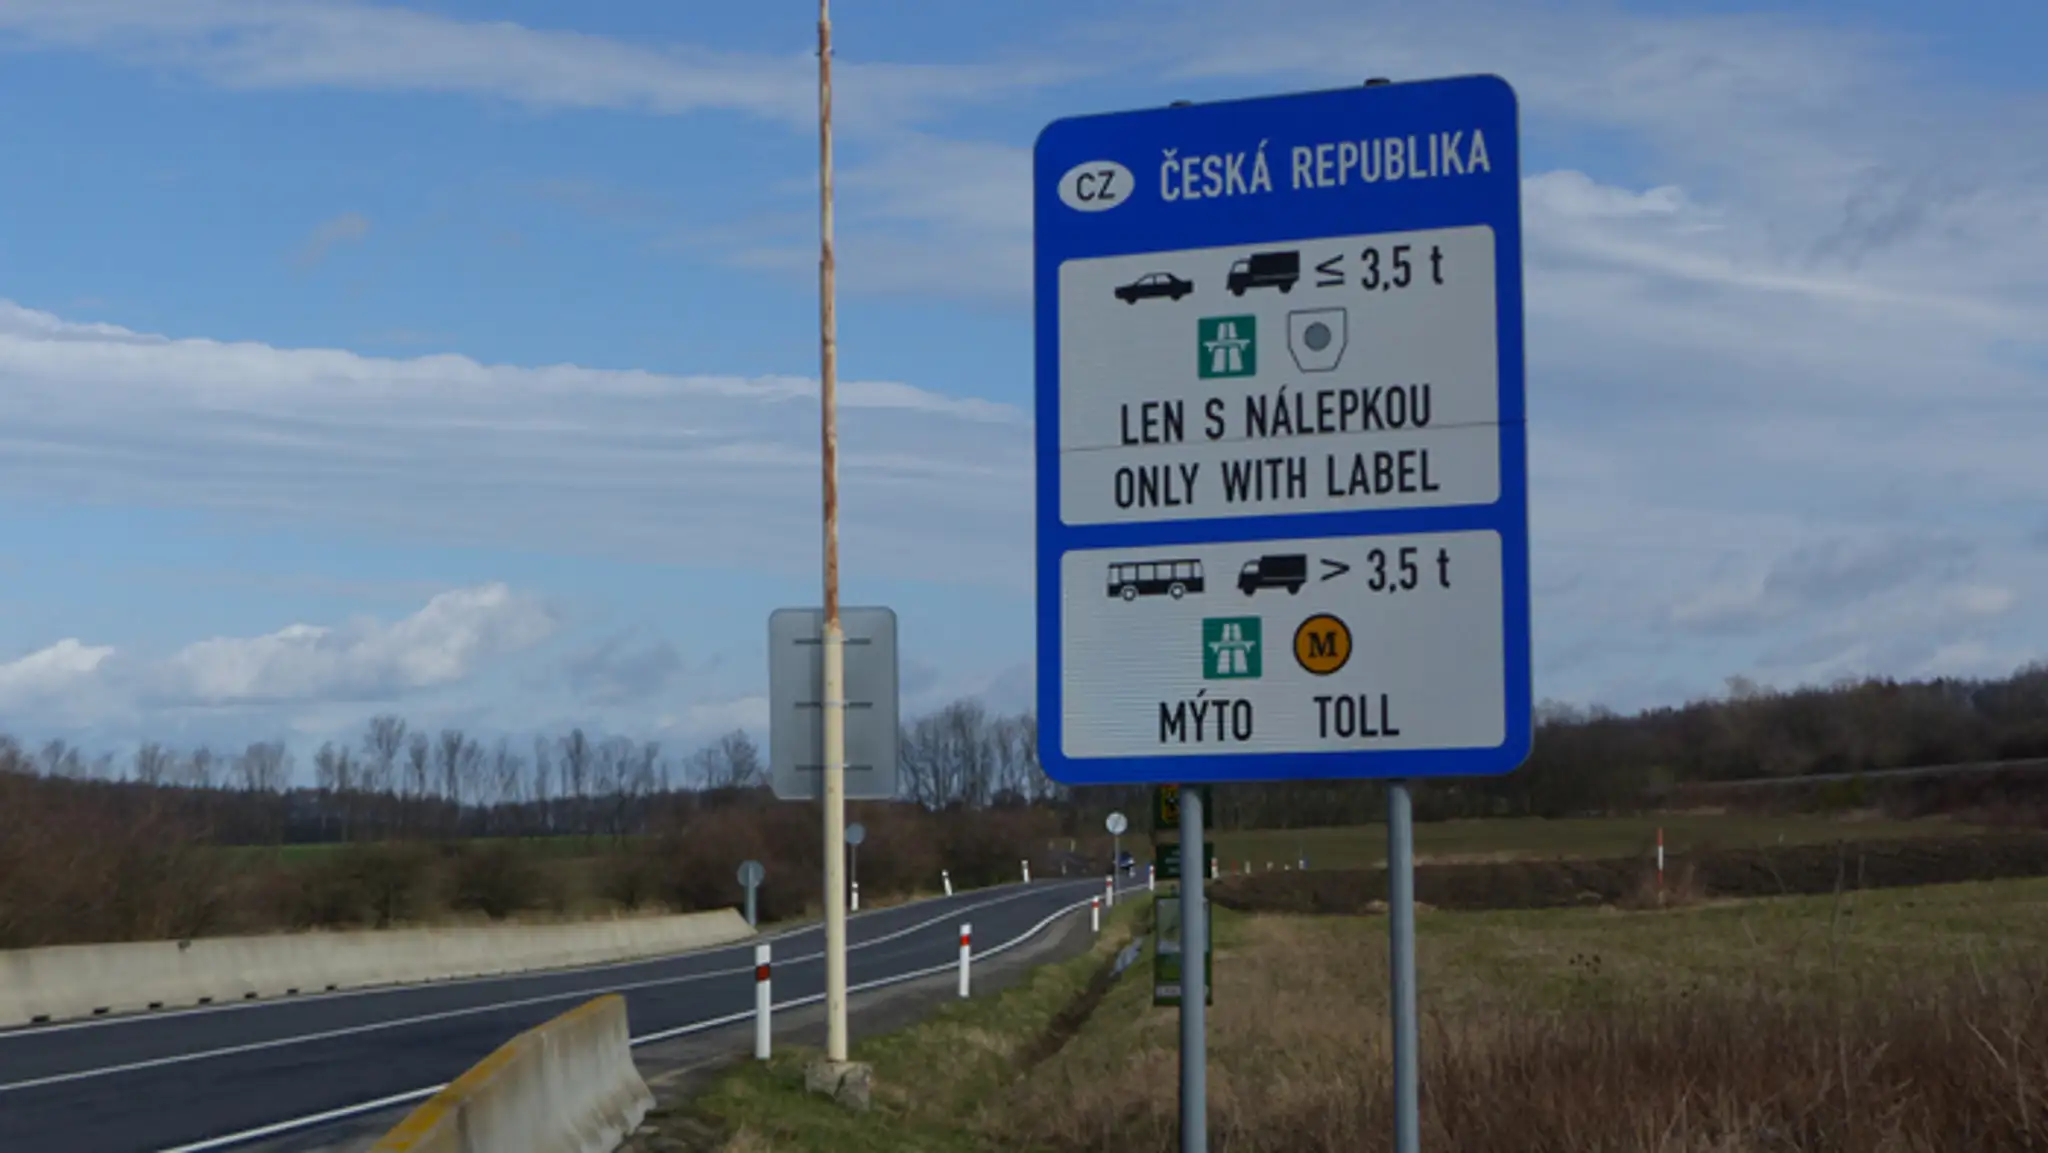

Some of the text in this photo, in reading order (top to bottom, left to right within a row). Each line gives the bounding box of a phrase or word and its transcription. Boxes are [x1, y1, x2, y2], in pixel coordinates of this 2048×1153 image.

[1076, 170, 1116, 201] CZ
[1160, 129, 1492, 202] ČESKÁ REPUBLIKA
[1360, 245, 1412, 292] 3,5
[1430, 245, 1444, 285] t
[1121, 384, 1431, 446] LEN S NÁLEPKOU
[1114, 449, 1440, 509] ONLY WITH LABEL
[1366, 547, 1418, 594] 3,5
[1436, 547, 1451, 589] t
[1307, 632, 1338, 658] M
[1159, 688, 1400, 744] MÝTO TOLL
